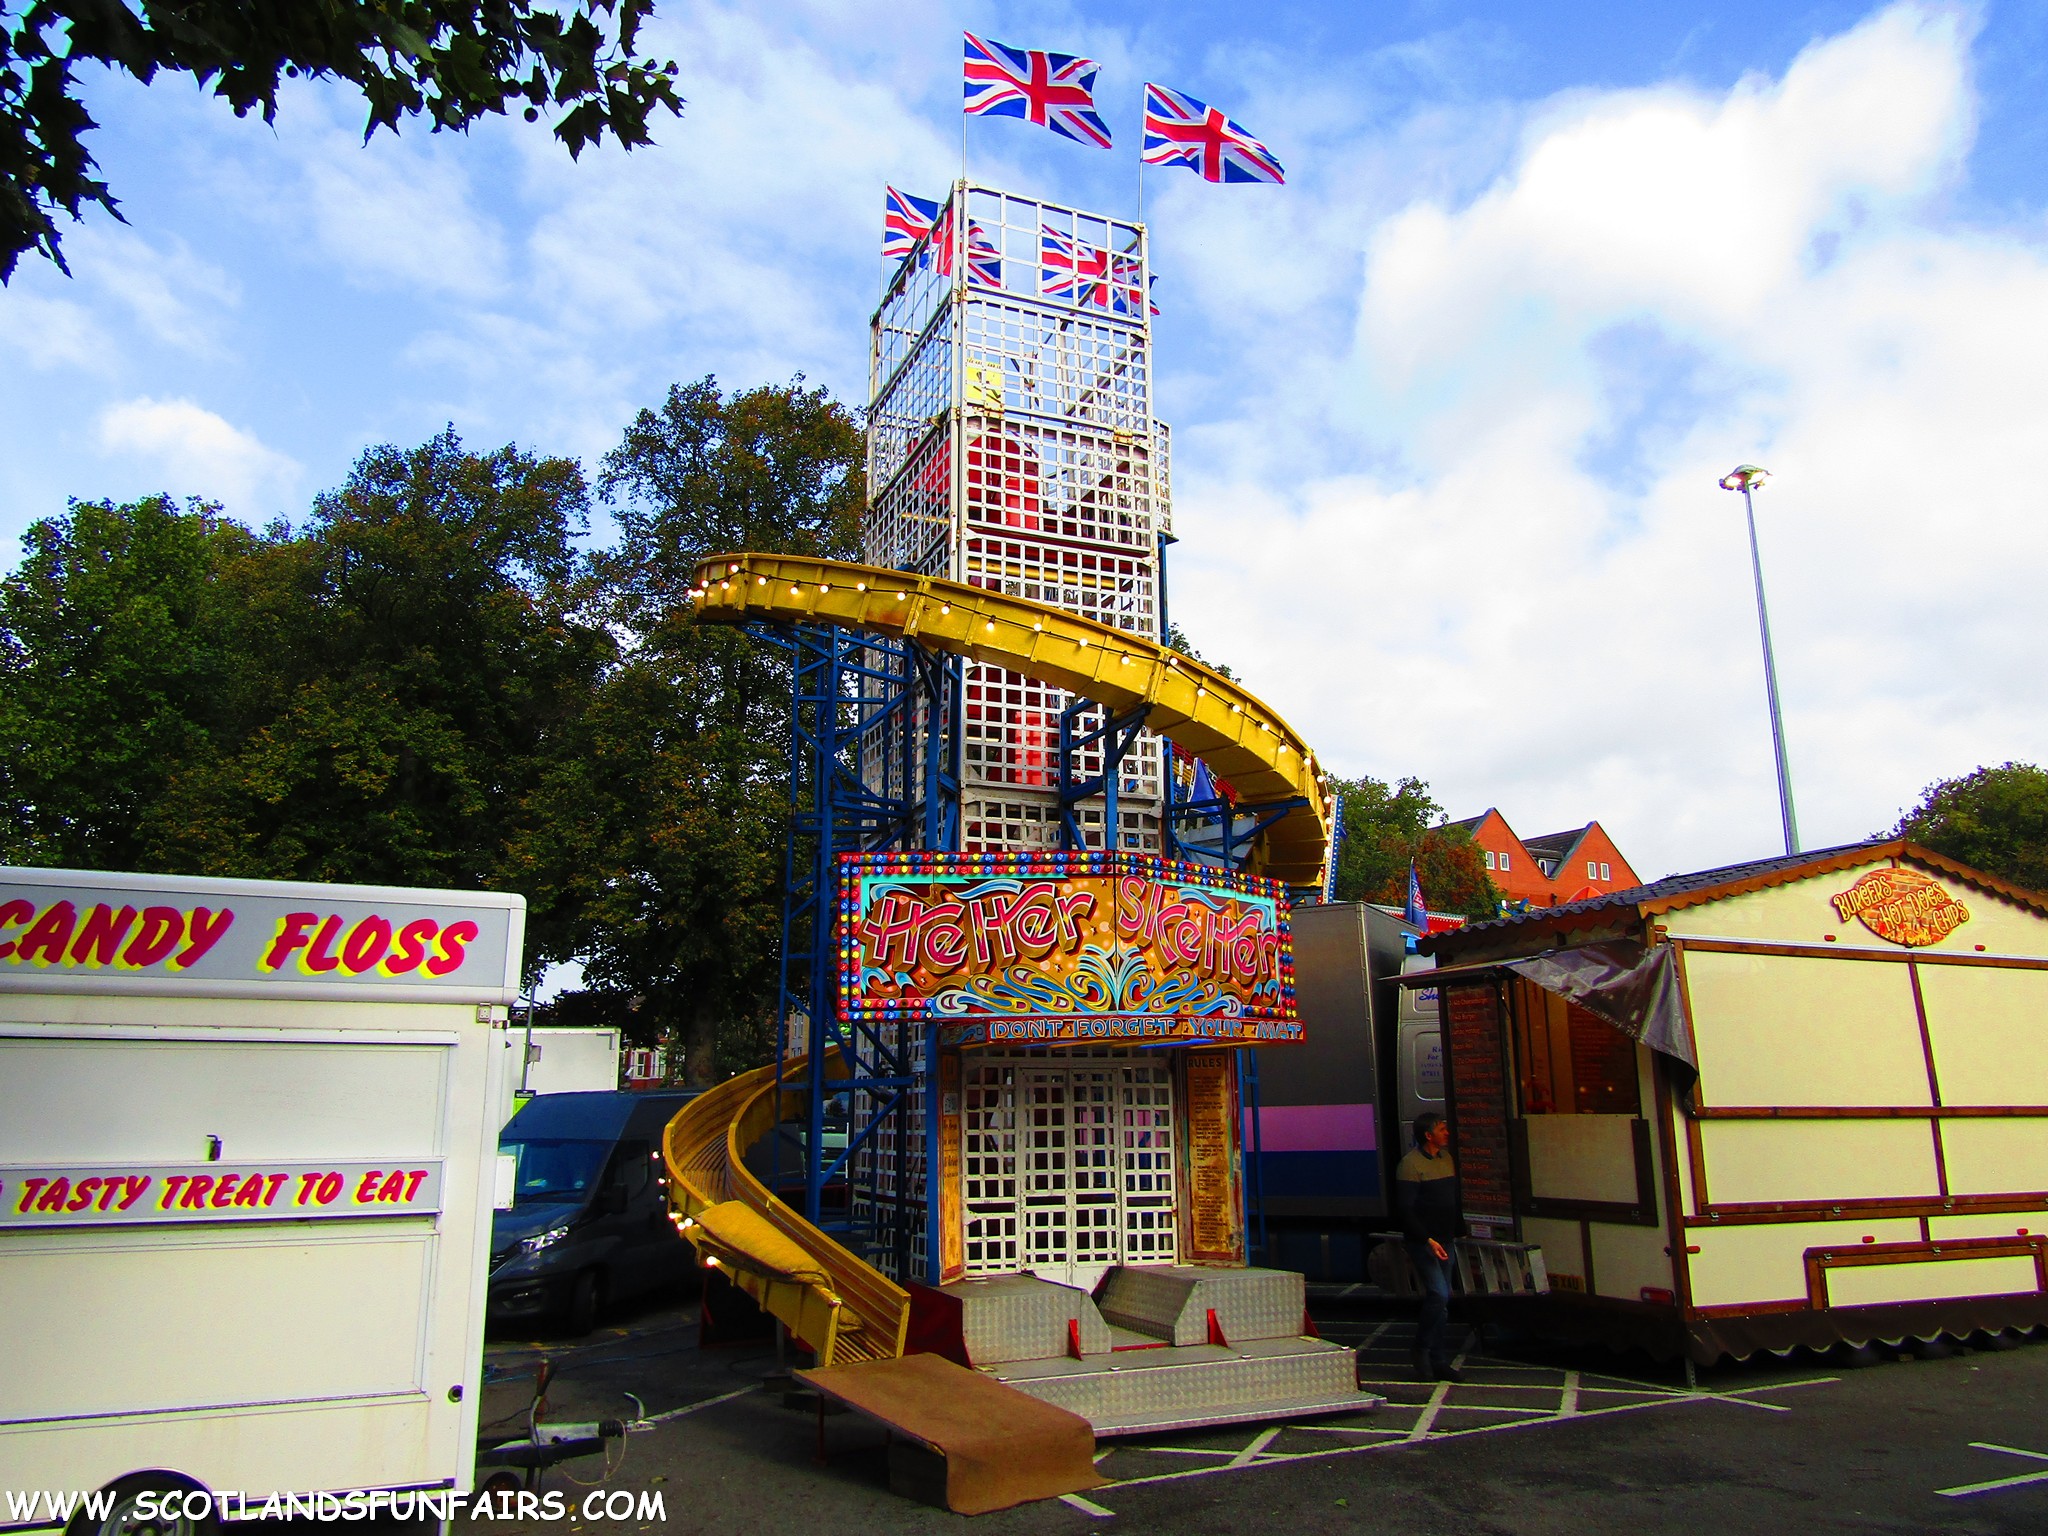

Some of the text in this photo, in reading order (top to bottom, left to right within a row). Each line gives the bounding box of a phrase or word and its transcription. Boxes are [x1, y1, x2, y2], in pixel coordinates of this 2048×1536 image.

[1833, 875, 1892, 921] BURGERS
[1879, 881, 1946, 932] HOT DOGS
[1932, 899, 1970, 935] CHIPS
[0, 899, 480, 979] CANDY FLOSS
[862, 874, 1280, 976] Helter Skelter
[993, 1017, 1304, 1040] DONT FORGET YOUR MAT
[1187, 1058, 1222, 1068] RULES
[16, 1175, 151, 1213] TASTY
[158, 1173, 289, 1210] TREAT
[299, 1172, 345, 1206] TO
[354, 1170, 428, 1204] EAT
